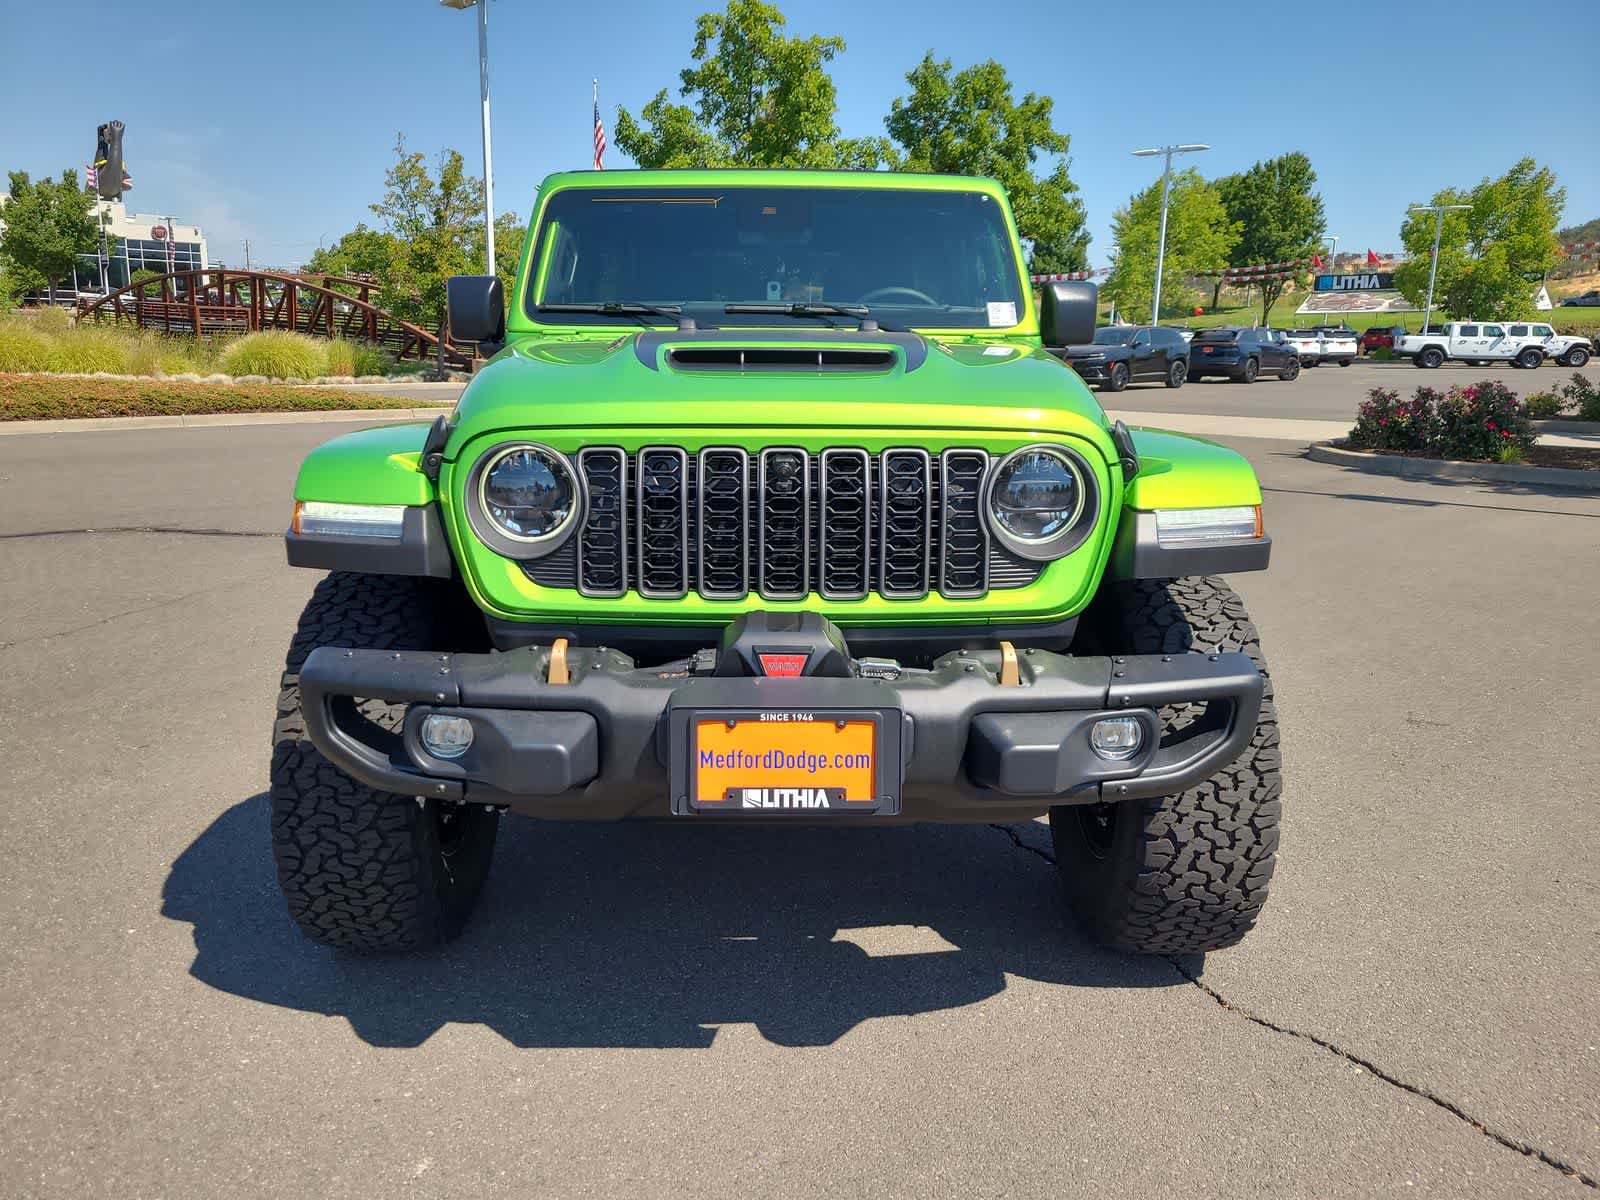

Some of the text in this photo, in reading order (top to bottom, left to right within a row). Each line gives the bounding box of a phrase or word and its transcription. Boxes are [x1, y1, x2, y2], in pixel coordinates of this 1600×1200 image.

[1333, 274, 1380, 290] LITHIA
[760, 713, 814, 721] SINCE 1946
[700, 750, 870, 773] MedfordDodge.com
[762, 788, 830, 808] LITHIA
